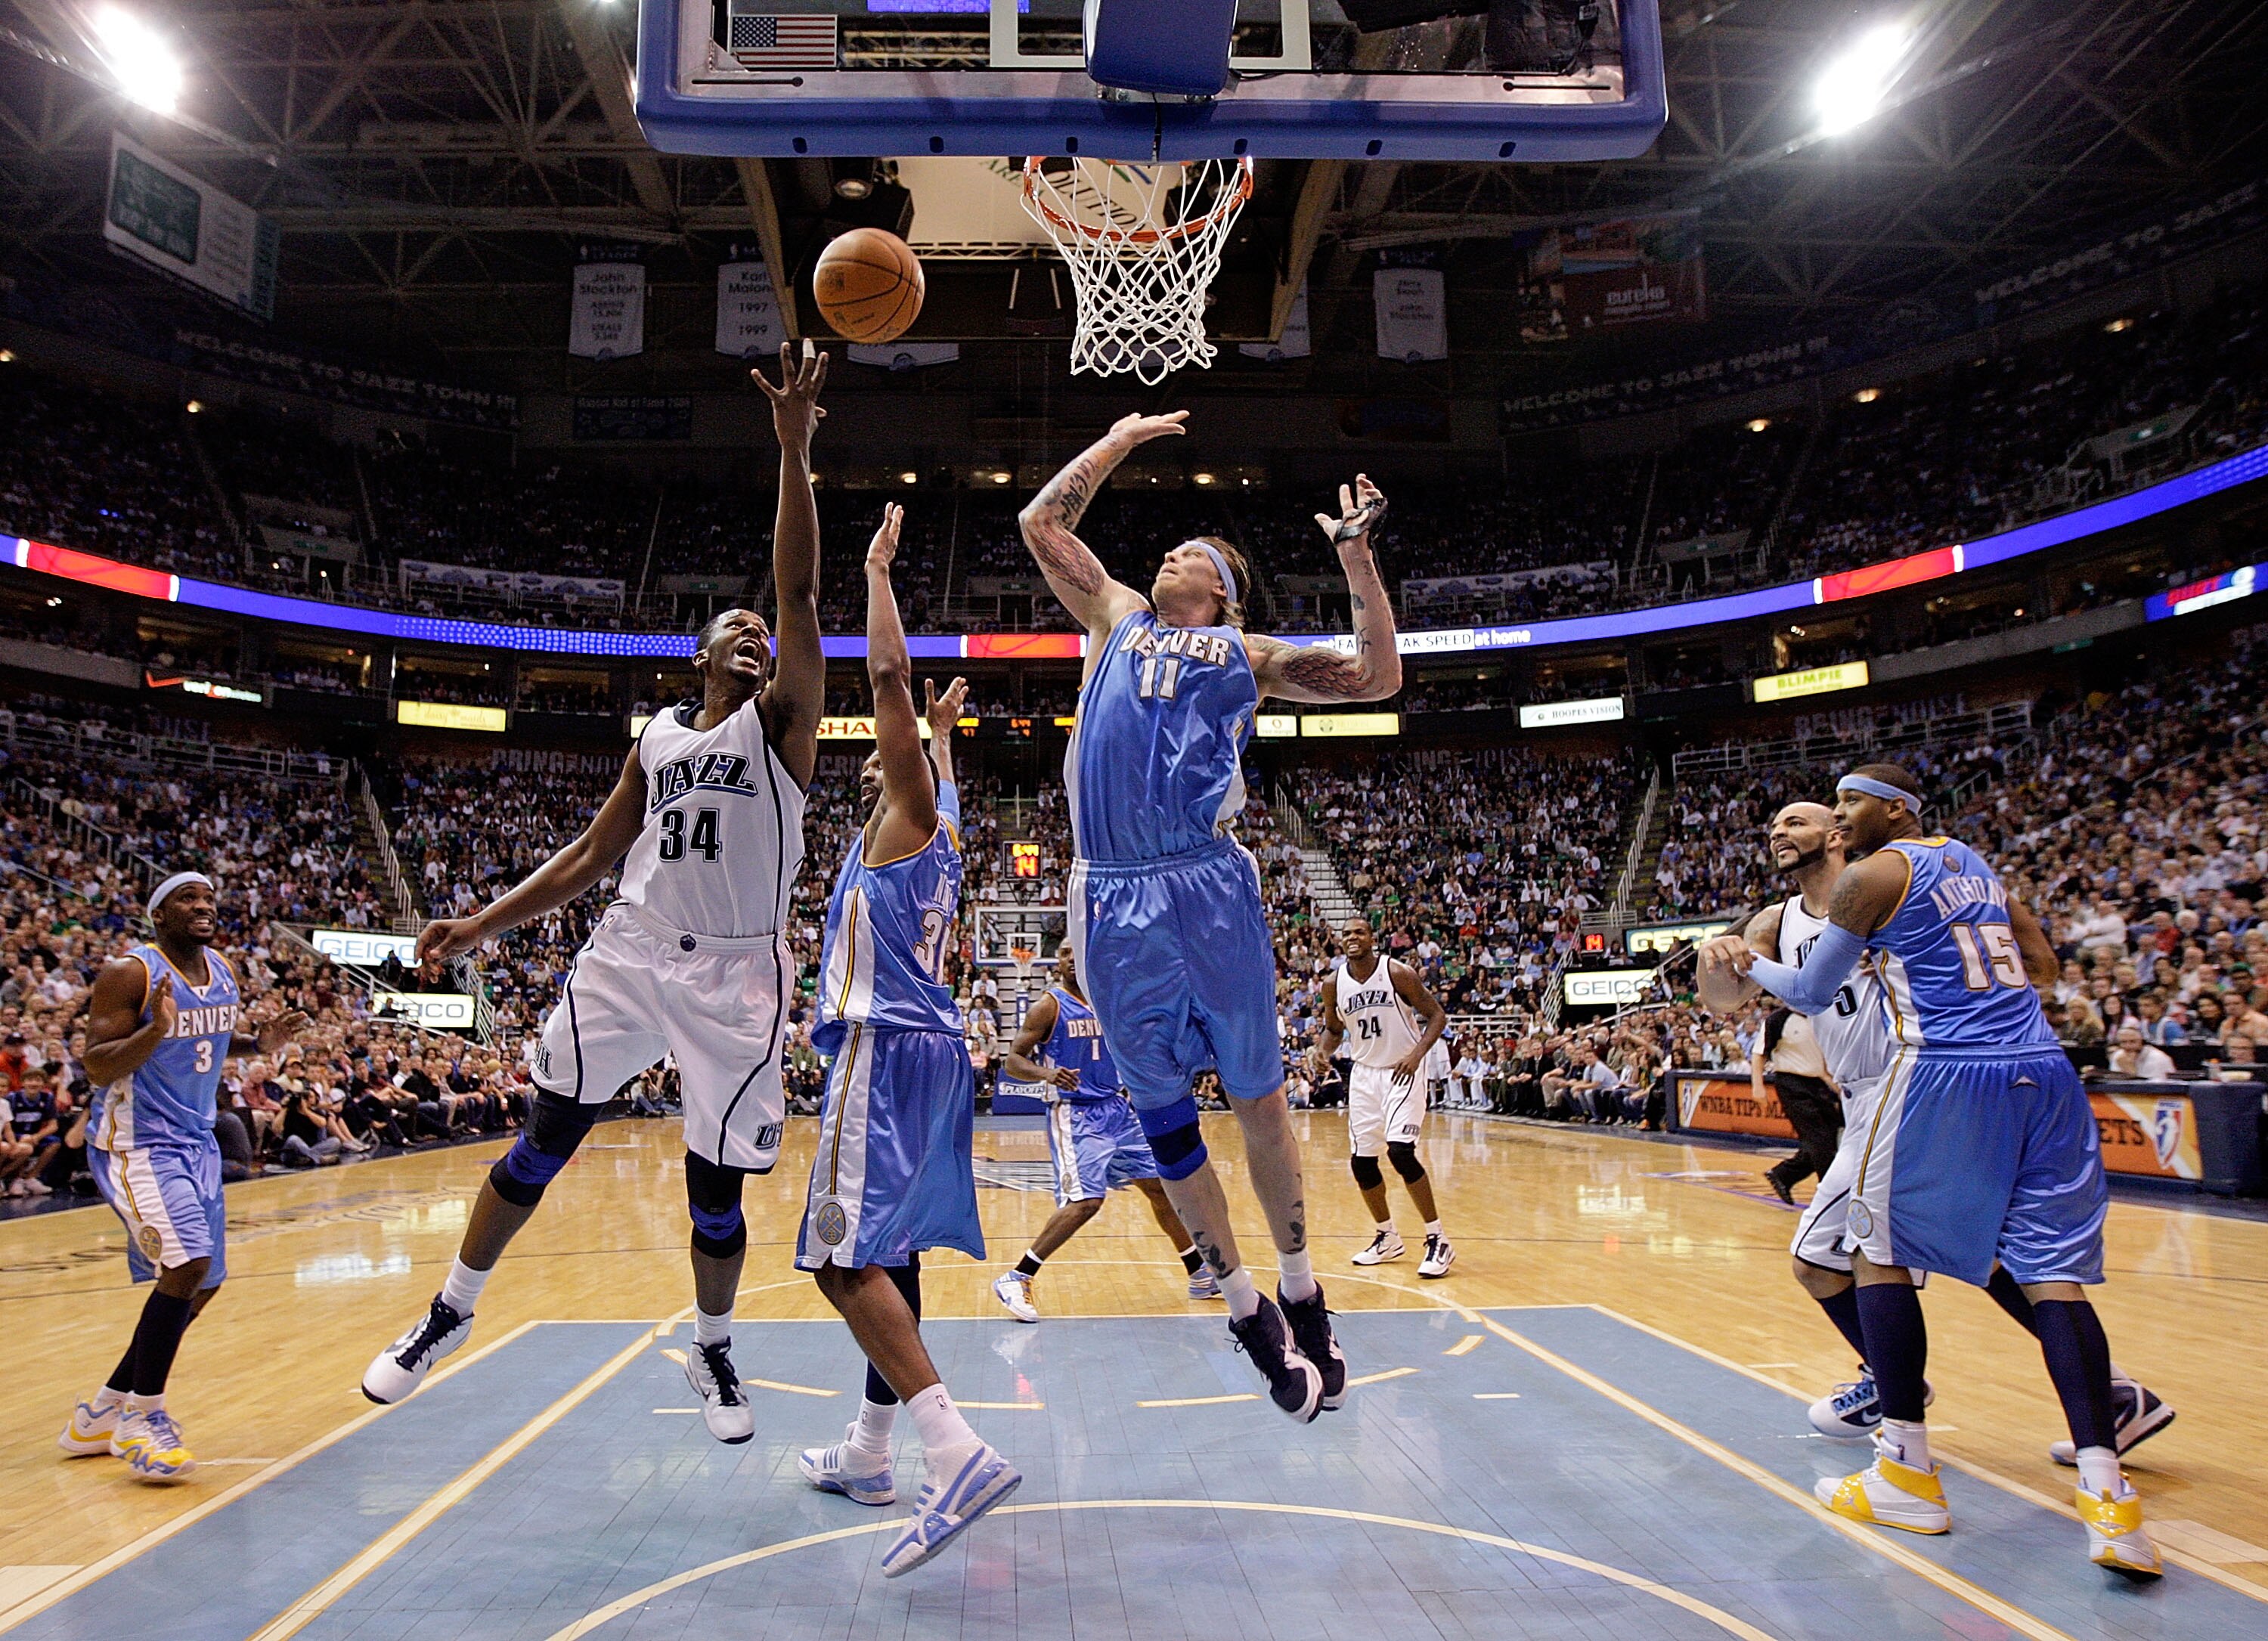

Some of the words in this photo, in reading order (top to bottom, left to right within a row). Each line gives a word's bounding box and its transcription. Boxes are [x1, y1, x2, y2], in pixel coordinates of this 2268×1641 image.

[1049, 170, 1146, 231] OLUTIO
[742, 271, 767, 281] Karl
[739, 302, 767, 313] 1997
[739, 325, 767, 336] 1999
[1426, 633, 1471, 647] SPEED
[1474, 631, 1490, 646] at
[1492, 628, 1532, 645] home
[1139, 658, 1180, 699] 11
[1777, 668, 1843, 689] BLIMPIE
[1590, 704, 1622, 715] VISION
[816, 721, 875, 737] SHA
[649, 751, 759, 815] JAZZ
[658, 807, 723, 863] 34
[1950, 922, 2029, 992] 15
[1344, 989, 1394, 1016] JAZZ
[1067, 1018, 1103, 1039] DENV
[1357, 1016, 1382, 1040] 24
[194, 1039, 213, 1073] 3
[1091, 1039, 1101, 1060] 1
[1701, 1095, 1734, 1115] WNBA
[2097, 1119, 2145, 1146] ETS
